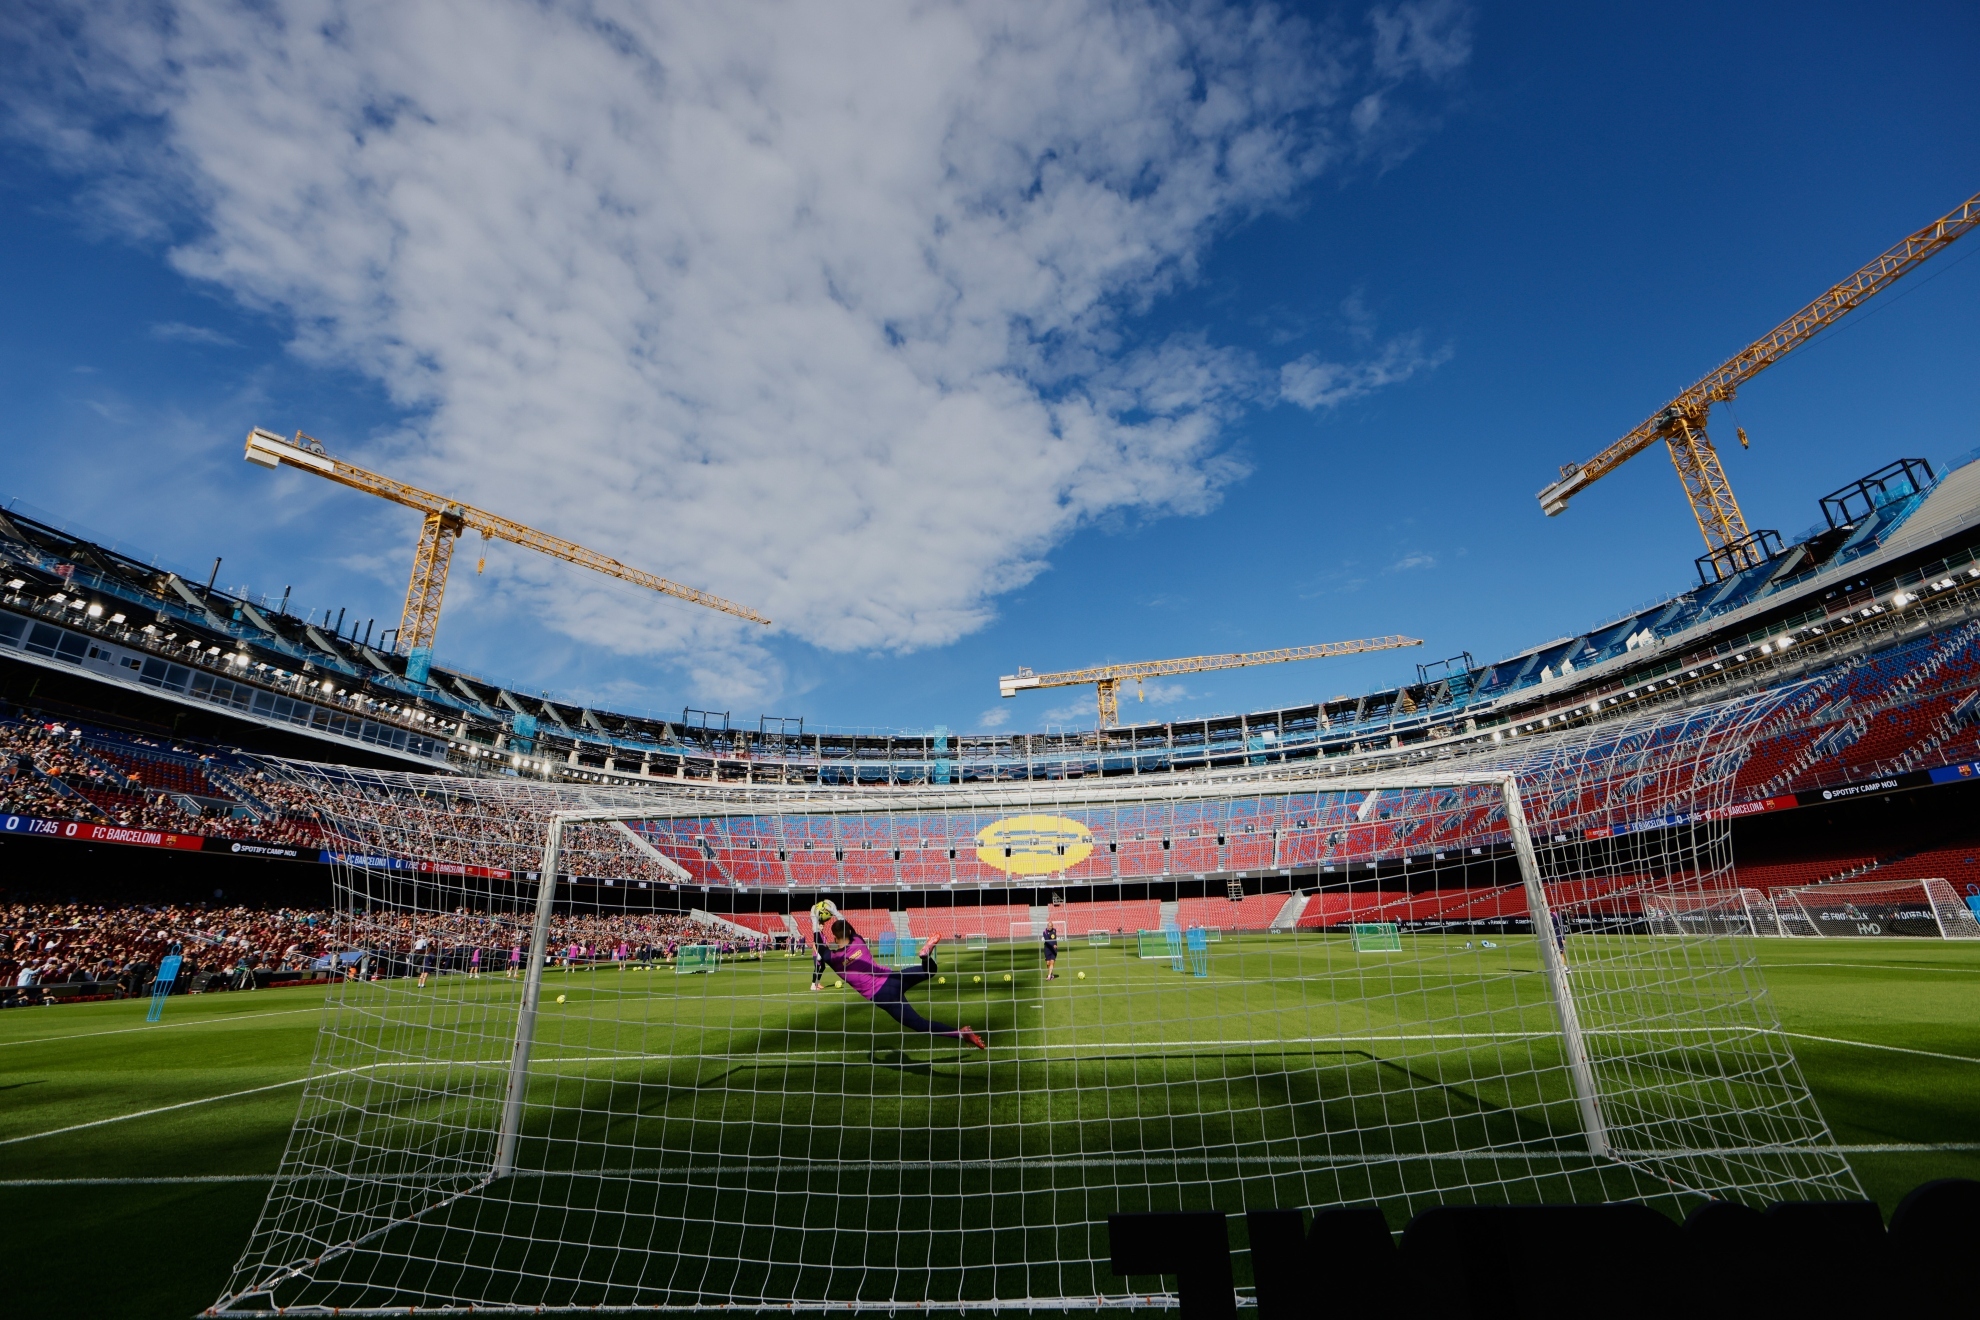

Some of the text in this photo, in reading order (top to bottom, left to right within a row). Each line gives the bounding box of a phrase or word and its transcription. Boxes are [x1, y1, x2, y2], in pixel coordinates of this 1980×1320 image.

[1832, 780, 1898, 797] SPOTIFY CAMP NOU
[1728, 802, 1764, 816] BARCELONA
[6, 816, 161, 845] 0 17:45 0 FC BARCELONA
[240, 845, 297, 857] SPOTIFY CAMP NOU
[354, 856, 387, 867] BARCELONA
[1857, 923, 1881, 935] HMD
